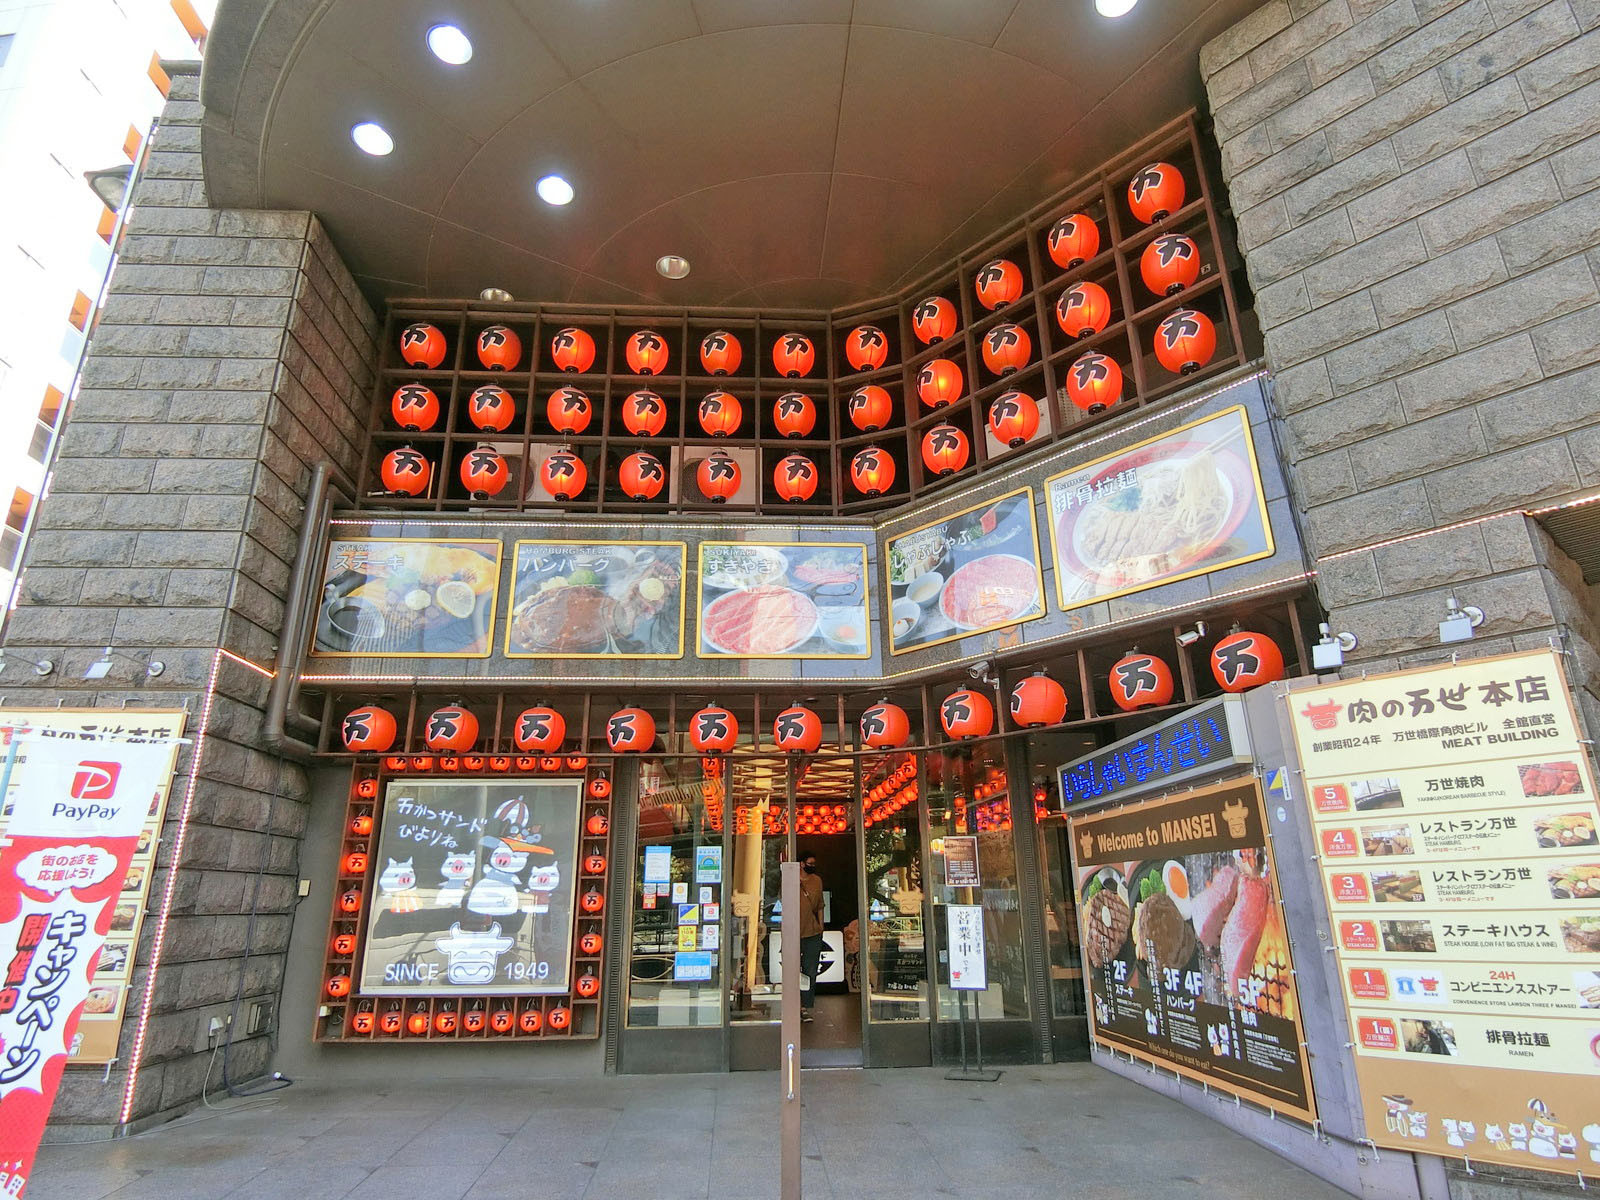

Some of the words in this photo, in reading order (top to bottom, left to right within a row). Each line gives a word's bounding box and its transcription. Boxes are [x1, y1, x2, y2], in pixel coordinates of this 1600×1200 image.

[1131, 163, 1163, 203] 万
[1050, 215, 1077, 250] 万
[1153, 234, 1193, 268] 万
[977, 260, 1004, 294] 万
[914, 297, 939, 328] 万
[1058, 283, 1085, 321] 万
[402, 324, 431, 349] 万
[480, 325, 508, 351] 万
[553, 329, 577, 355] 万
[636, 331, 662, 352] 万
[859, 326, 883, 349] 万
[988, 324, 1019, 355] 万
[1162, 310, 1200, 351] 万
[704, 331, 728, 358] 万
[784, 333, 809, 356] 万
[1074, 354, 1108, 391] 万
[399, 387, 430, 411] 万
[475, 388, 504, 413] 万
[562, 390, 588, 414] 万
[634, 393, 660, 416] 万
[700, 393, 724, 422] 万
[779, 393, 805, 420] 万
[992, 394, 1020, 428] 万
[930, 428, 959, 456] 万
[394, 451, 424, 476] 万
[470, 451, 501, 477] 万
[548, 455, 577, 480] 万
[638, 456, 662, 482] 万
[708, 457, 736, 482] 万
[785, 458, 813, 482] 万
[854, 449, 880, 479] 万
[1054, 474, 1091, 491] Ramen
[710, 549, 757, 557] SUKIYAKI
[894, 529, 972, 568] しゃぶしゃぶ
[333, 553, 404, 571] ステーキ
[522, 556, 609, 572] ハンバーグ
[708, 559, 772, 574] すきやき
[1215, 638, 1261, 693] 万
[1115, 658, 1159, 700] 万
[860, 707, 887, 736] 万
[941, 694, 972, 730] 万
[343, 712, 372, 745] 万
[429, 712, 463, 743] 万
[520, 714, 552, 743] 万
[608, 713, 637, 747] 万
[698, 713, 729, 742] 万
[776, 712, 806, 744] 万
[1313, 734, 1381, 752] 創業昭和24年
[1393, 722, 1488, 742] 万世橋際角肉ビル
[1502, 714, 1556, 730] 全館直営
[1442, 736, 1482, 749] MEAT
[1488, 728, 1559, 744] BUILDING
[1324, 788, 1336, 800] 5
[1425, 775, 1485, 792] 万世焼肉
[52, 803, 121, 821] PayPay
[399, 824, 458, 848] びよりね
[1097, 832, 1144, 853] Welcome
[1145, 826, 1159, 846] to
[1161, 813, 1218, 844] MANSEI
[1420, 816, 1517, 834] レストラン万世
[1333, 832, 1345, 843] 4
[352, 857, 362, 867] 万
[592, 859, 602, 869] 万
[1342, 877, 1355, 889] 3
[1432, 867, 1532, 883] レストラン万世
[344, 894, 355, 904] 万
[588, 895, 598, 905] 万
[1351, 923, 1365, 936] 2
[1442, 924, 1550, 938] ステーキハウス
[338, 940, 349, 949] 万
[584, 937, 594, 948] 万
[384, 963, 440, 982] SINCE
[504, 961, 549, 980] 1949
[1113, 960, 1128, 981] 2F
[1163, 967, 1181, 991] 3F
[1185, 971, 1204, 996] 4F
[1363, 971, 1371, 985] 1
[1489, 970, 1516, 981] 24H
[330, 981, 341, 991] 万
[582, 979, 593, 990] 万
[1115, 984, 1134, 998] ステーキ
[1238, 978, 1261, 1007] 5F
[1450, 981, 1571, 995] コンビニエンスストアー
[0, 910, 86, 1084] キャンペーン
[1167, 995, 1196, 1012] ハンバーグ
[358, 1017, 369, 1028] 万
[387, 1016, 399, 1027] 万
[444, 1016, 455, 1028] 万
[469, 1015, 480, 1026] 万
[497, 1014, 508, 1026] 万
[525, 1015, 536, 1027] 万
[553, 1011, 564, 1024] 万
[1241, 1009, 1258, 1027] 焼肉
